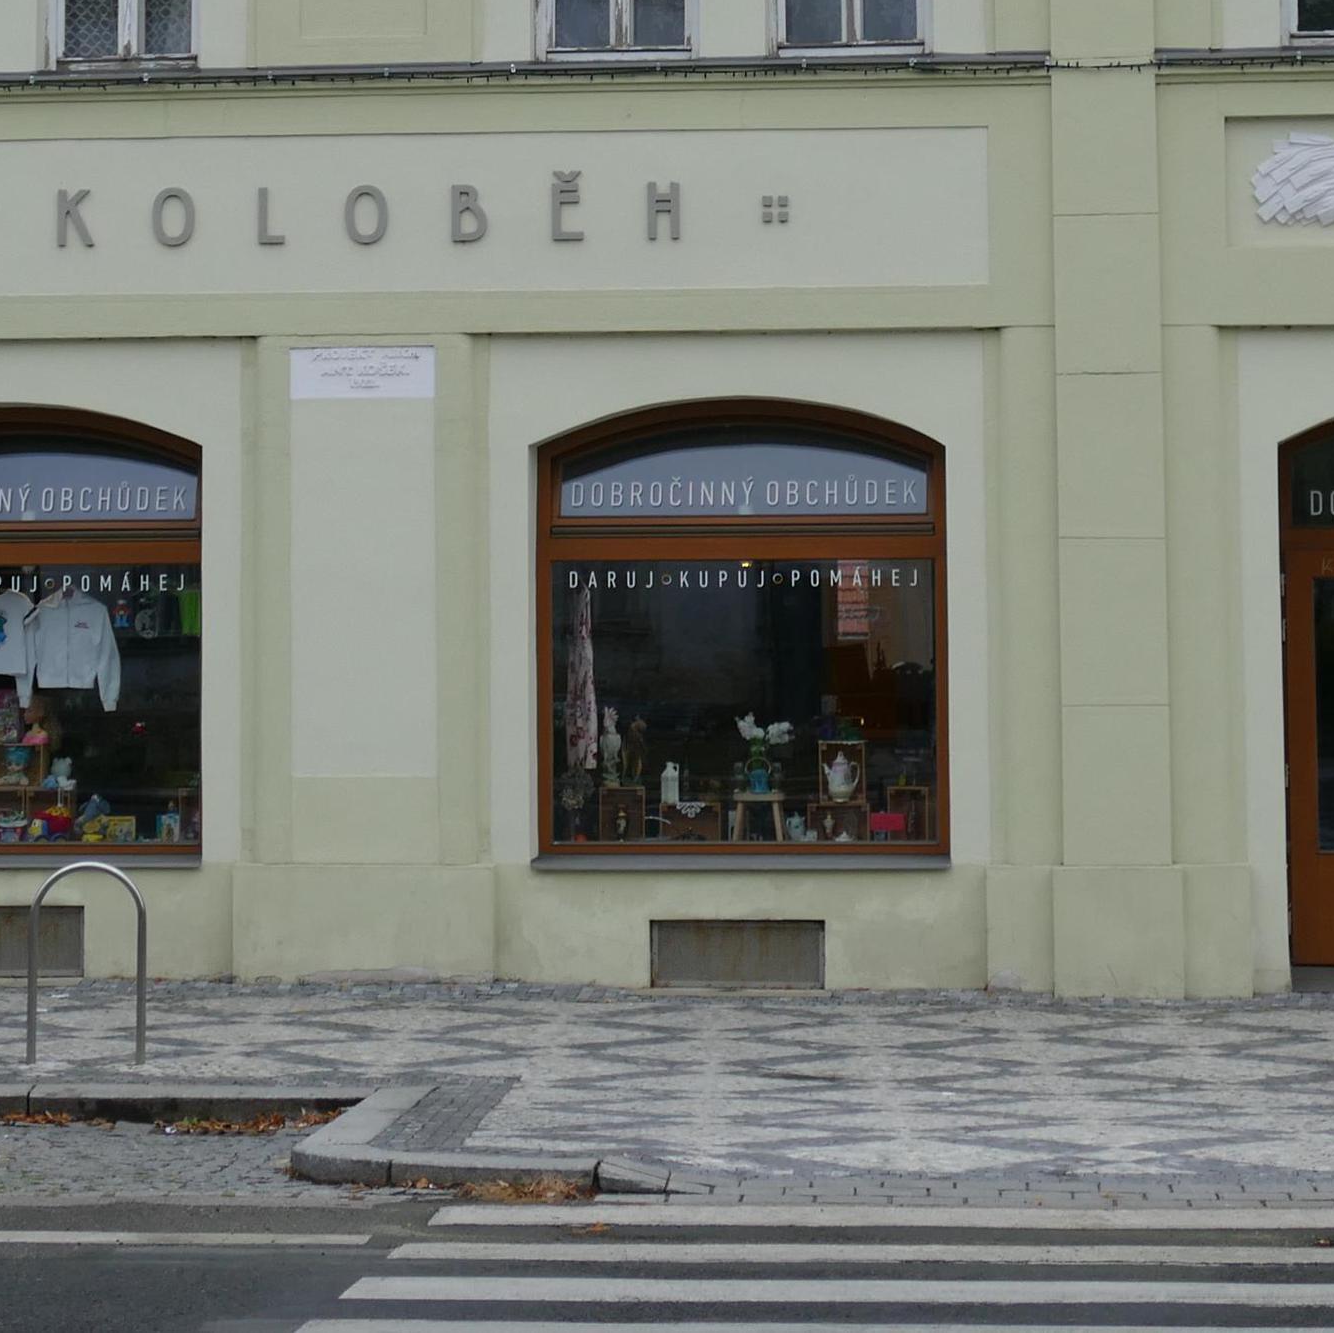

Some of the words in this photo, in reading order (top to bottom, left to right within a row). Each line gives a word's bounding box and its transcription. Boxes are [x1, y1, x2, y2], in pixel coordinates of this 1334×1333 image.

[56, 170, 681, 248] KOLOBĚH
[41, 481, 187, 512] OBCHŮDEK
[571, 477, 755, 507] DOBROČINNÝ
[766, 475, 918, 505] OBCHŮDEK
[63, 570, 185, 592] POMÁHEJ
[569, 571, 654, 589] DARUJ
[680, 569, 765, 589] KUPUJ
[791, 566, 918, 587] POMÁHEJ
